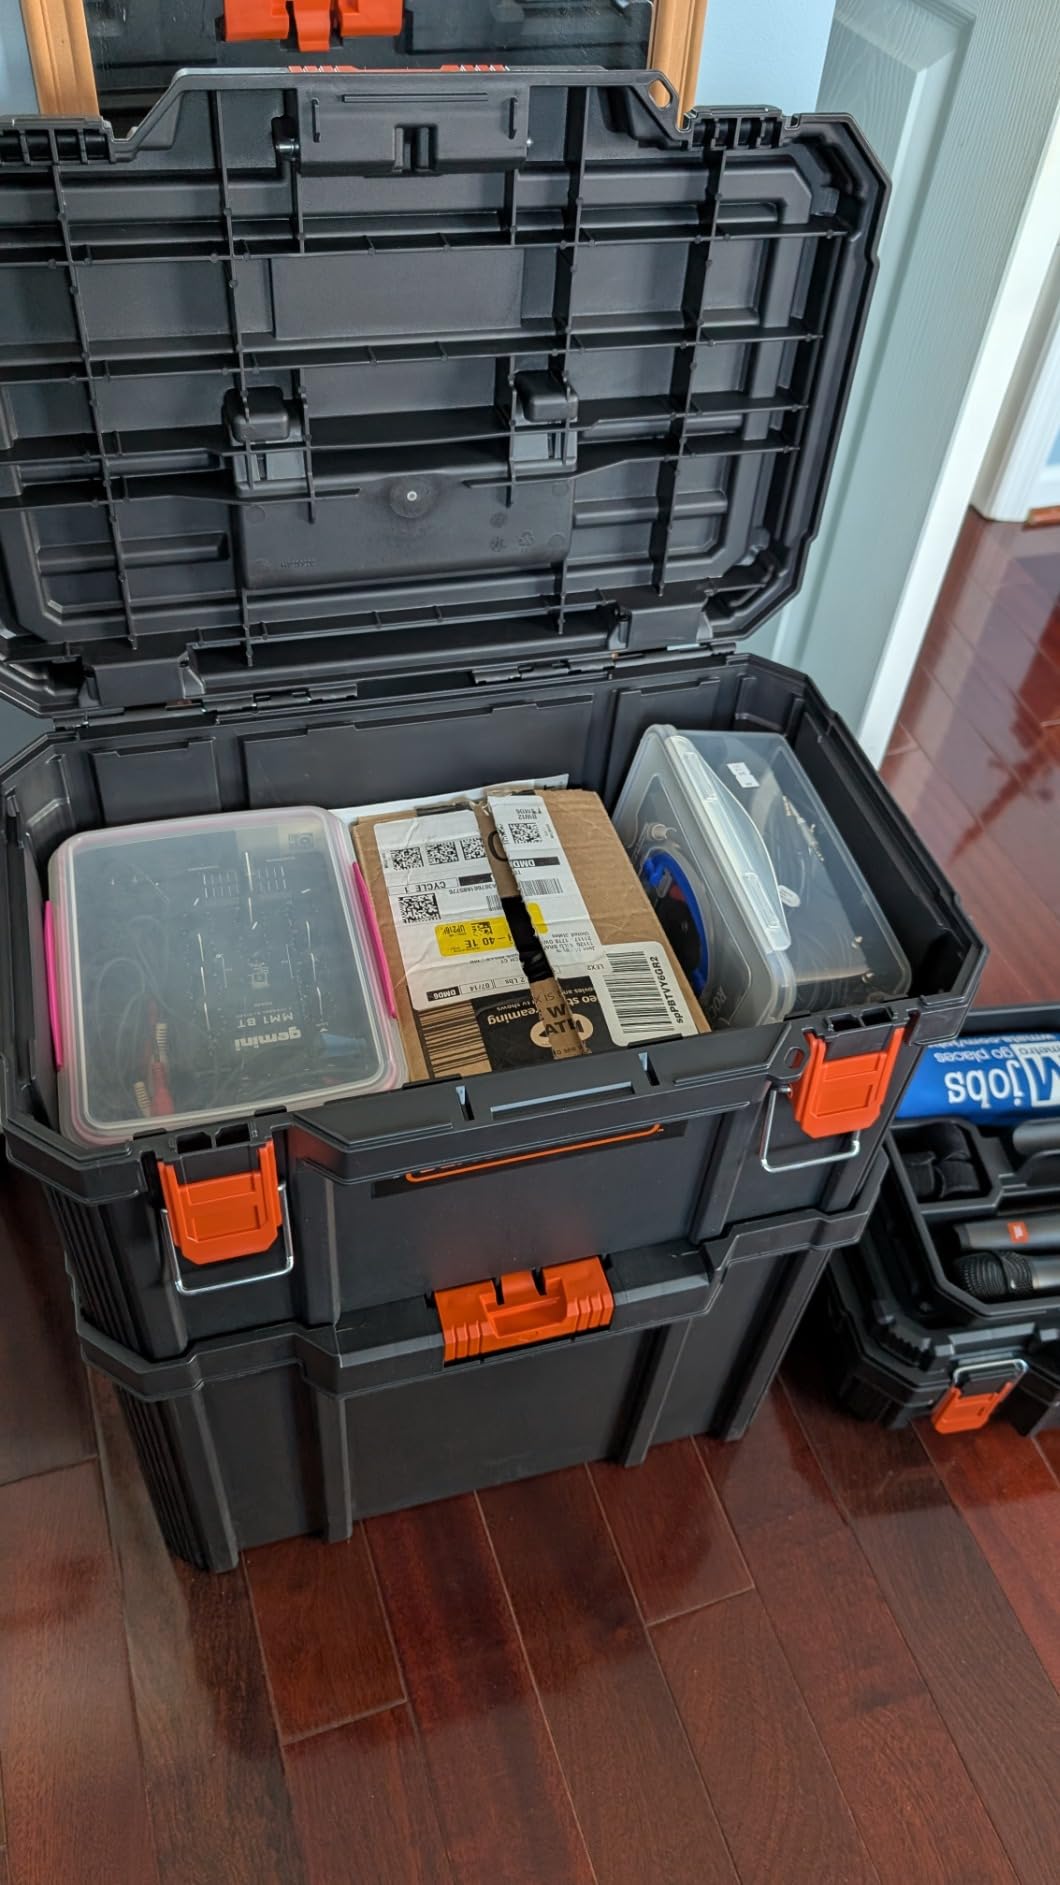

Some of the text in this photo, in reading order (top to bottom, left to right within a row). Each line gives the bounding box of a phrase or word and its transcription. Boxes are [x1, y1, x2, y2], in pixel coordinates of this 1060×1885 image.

[416, 881, 446, 892] CYCLE
[464, 939, 478, 948] 1E
[468, 983, 490, 992] 07/14
[582, 994, 597, 1003] eo
[237, 1017, 257, 1029] BT
[234, 1026, 302, 1052] gemini
[934, 1046, 1014, 1063] go places
[943, 1059, 1024, 1109] jobs
